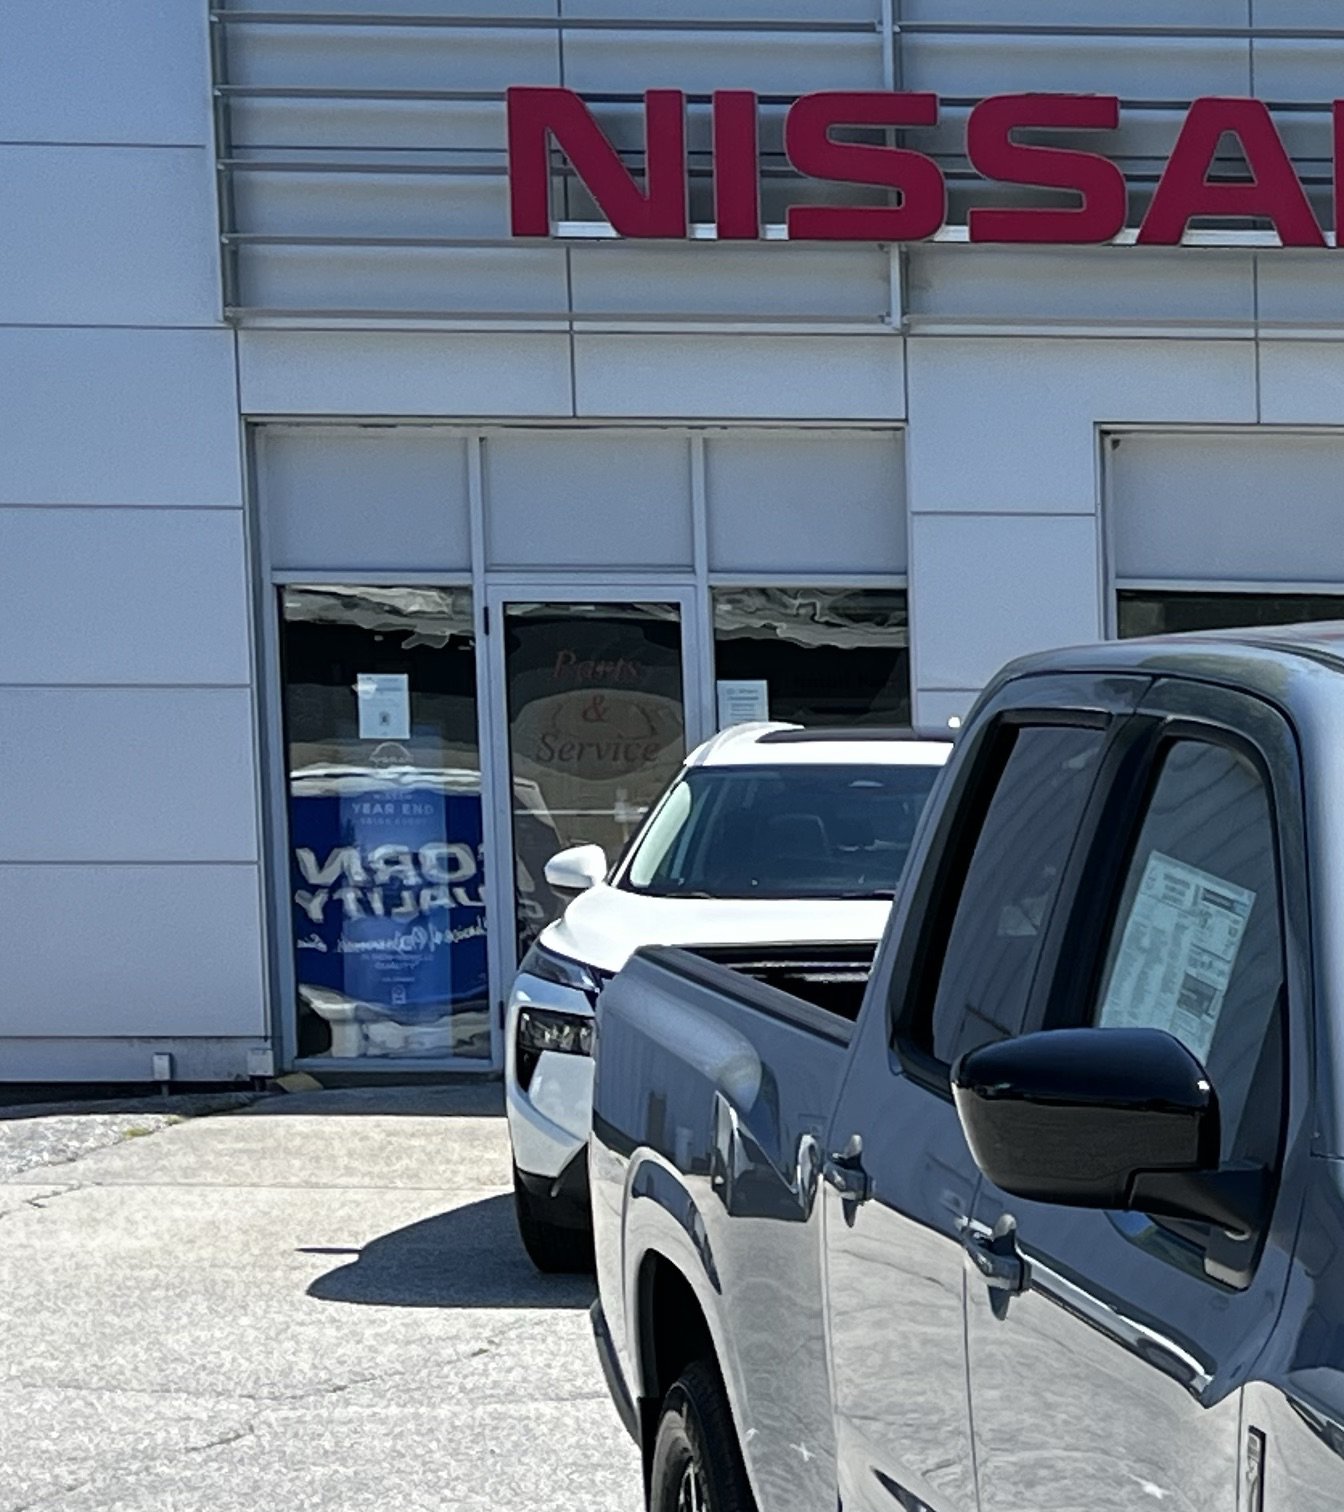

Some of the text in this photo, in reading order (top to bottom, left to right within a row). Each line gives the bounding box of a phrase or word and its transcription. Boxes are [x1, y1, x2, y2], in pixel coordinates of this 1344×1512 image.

[552, 650, 643, 680] Parts
[582, 692, 608, 723] &
[535, 732, 662, 763] Service
[352, 803, 434, 816] YEAR END
